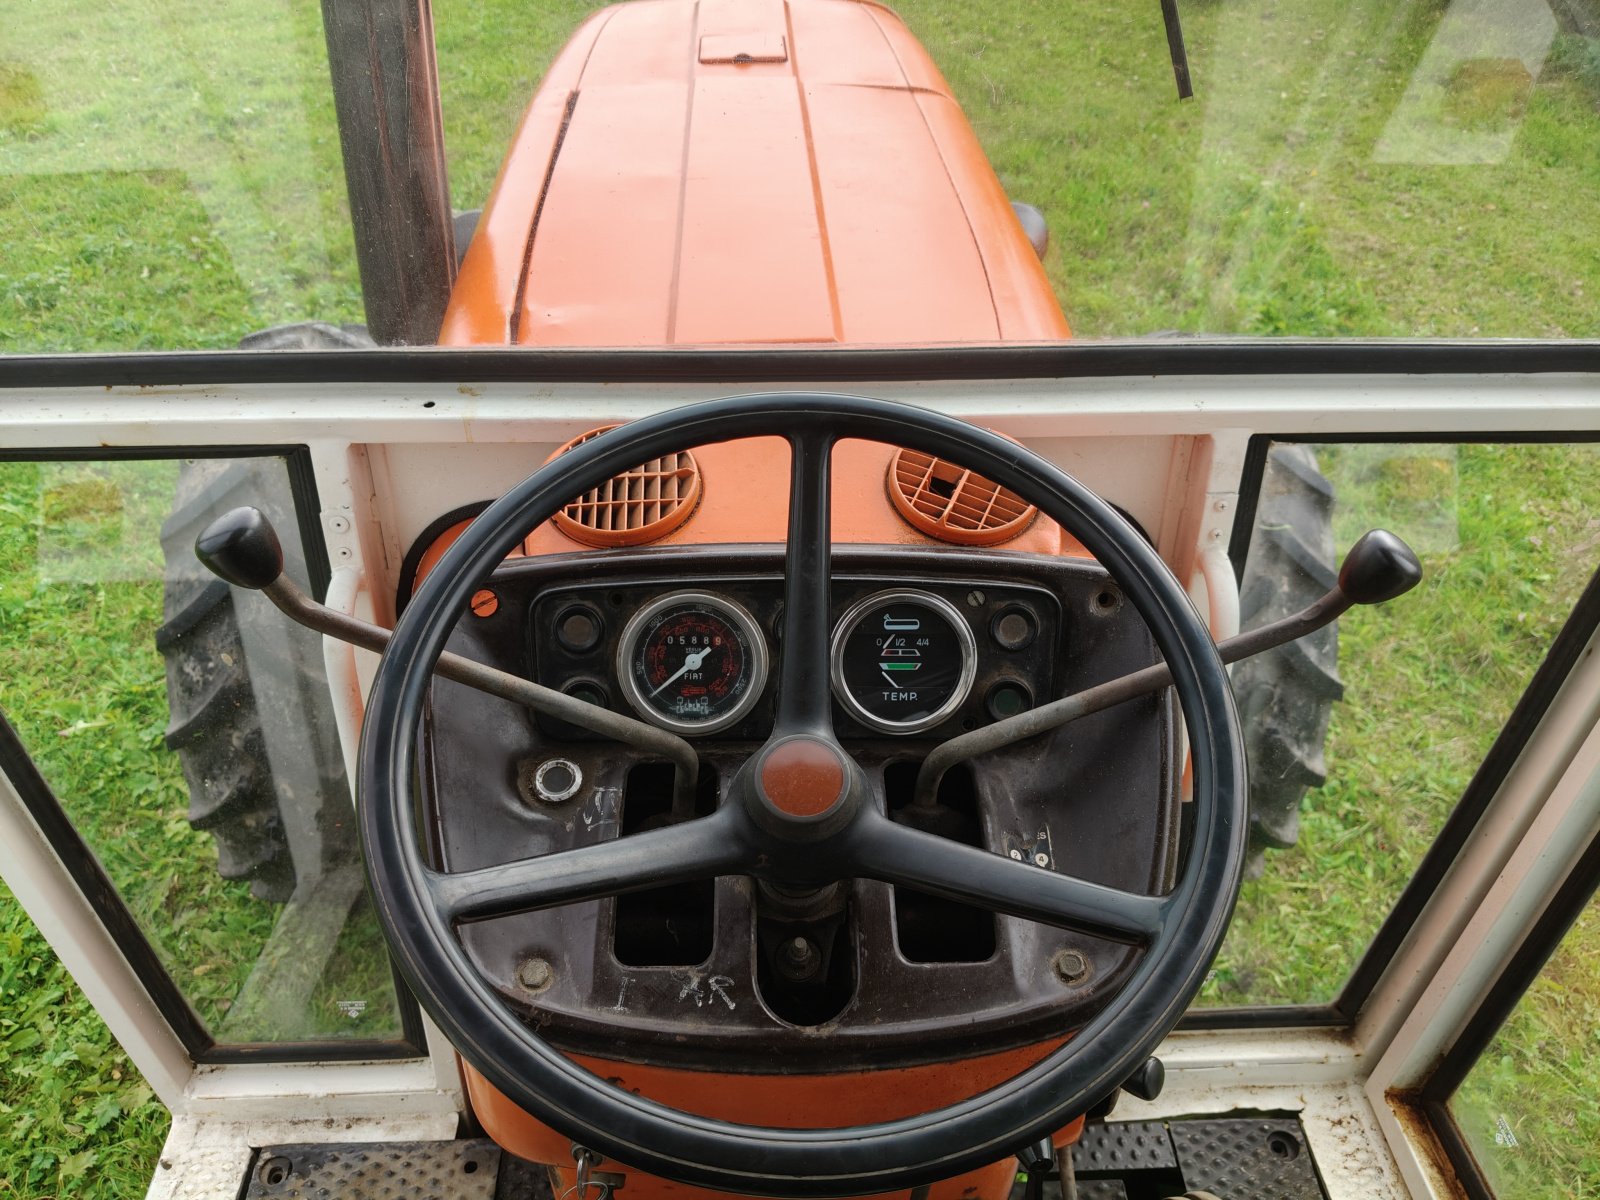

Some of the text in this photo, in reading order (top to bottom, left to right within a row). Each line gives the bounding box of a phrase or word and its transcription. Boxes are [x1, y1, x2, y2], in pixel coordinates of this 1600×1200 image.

[916, 638, 930, 646] 4/4
[684, 672, 703, 680] FIAT
[882, 691, 918, 701] TEMP.
